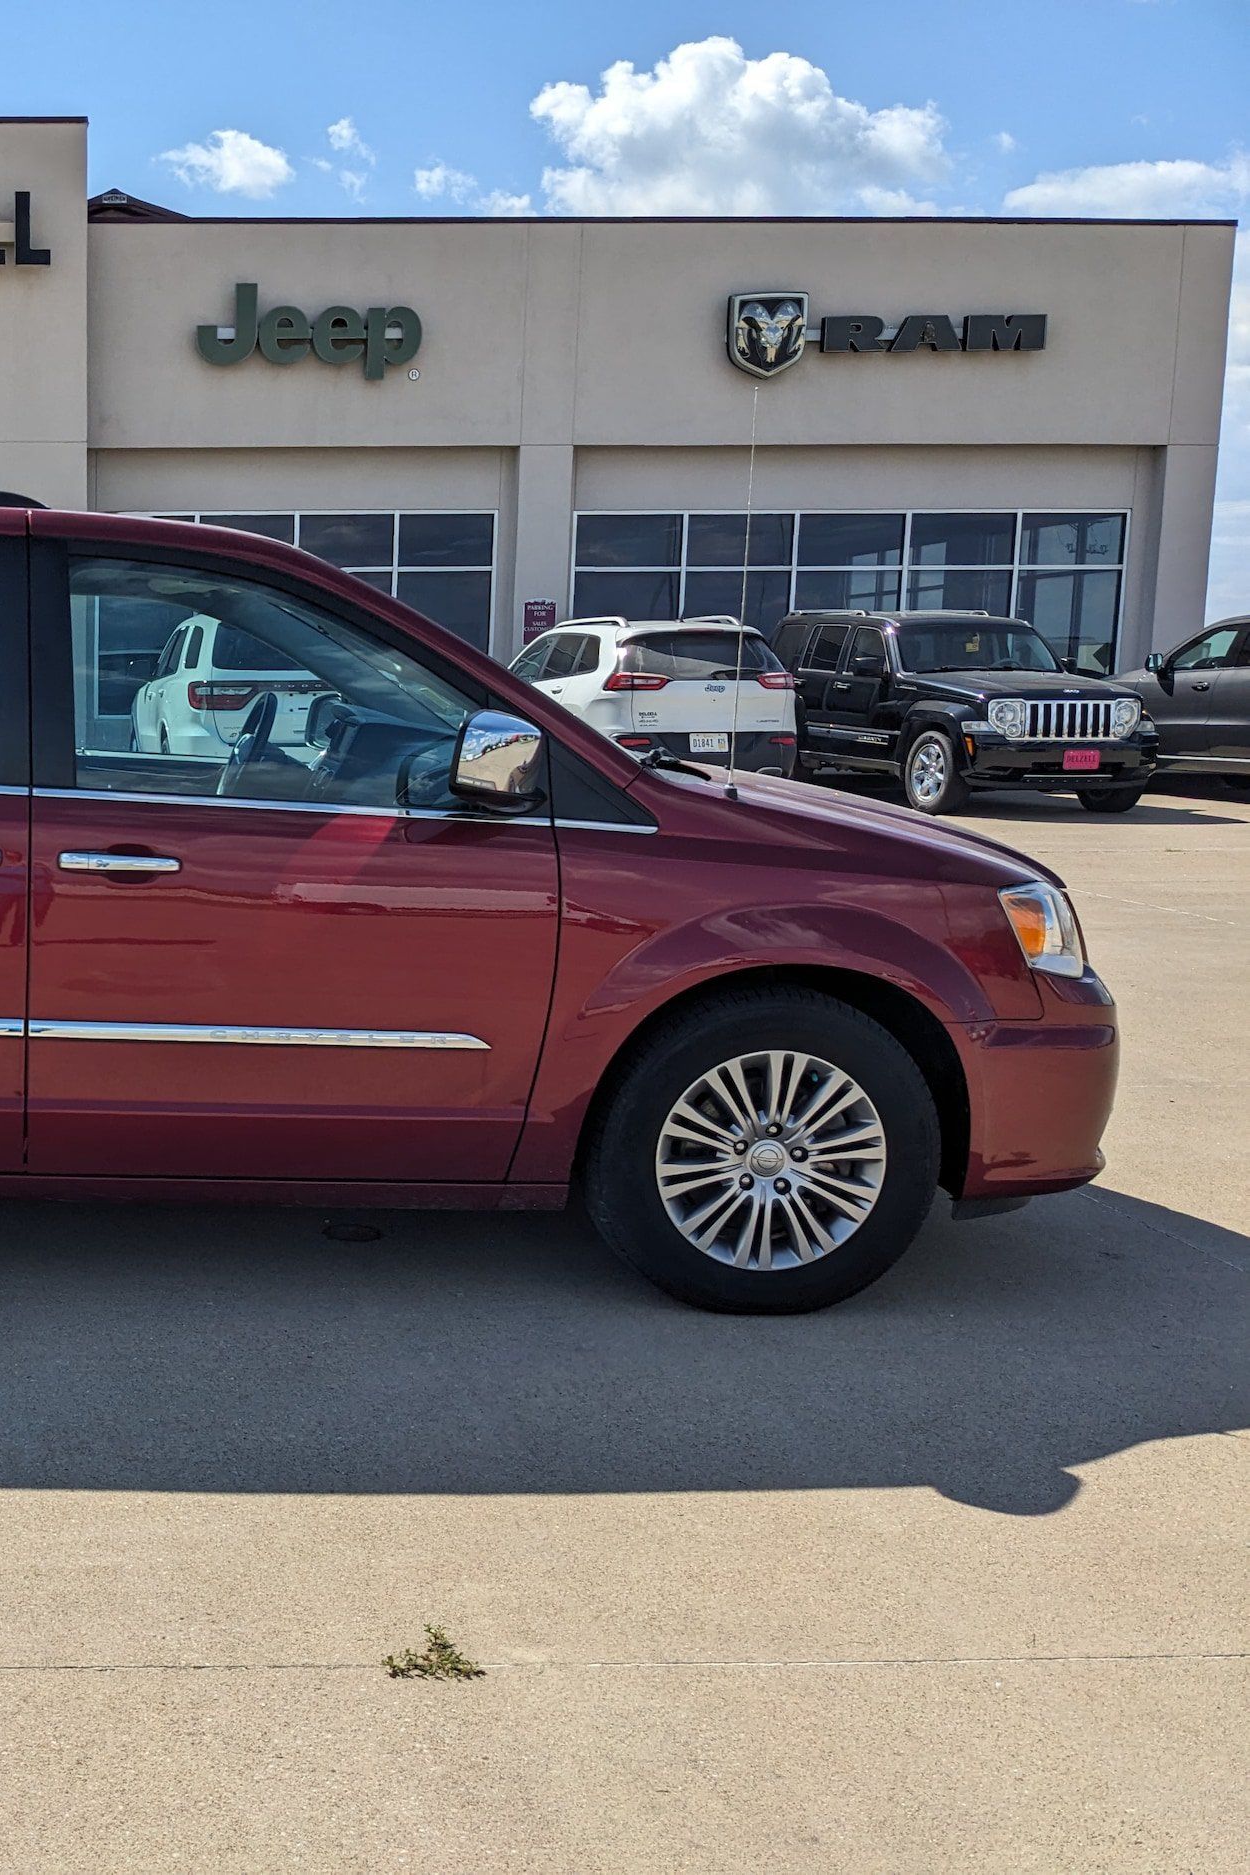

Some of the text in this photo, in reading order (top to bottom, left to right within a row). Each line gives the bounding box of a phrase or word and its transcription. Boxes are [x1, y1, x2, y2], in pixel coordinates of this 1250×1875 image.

[196, 283, 423, 380] Jeep
[819, 314, 1048, 353] RAM
[704, 684, 726, 693] Jeep
[210, 1030, 447, 1045] CHRYSLER
